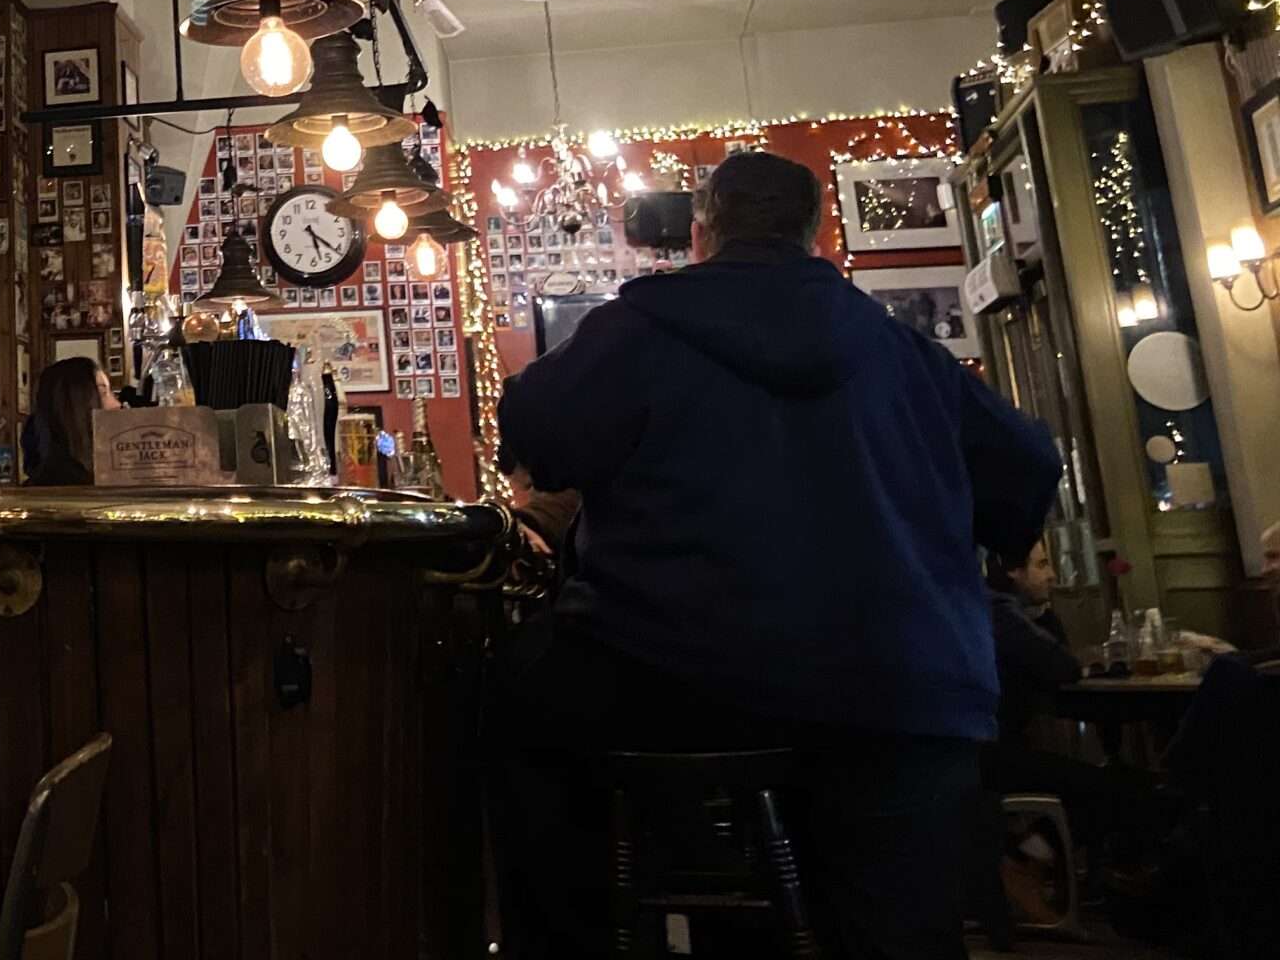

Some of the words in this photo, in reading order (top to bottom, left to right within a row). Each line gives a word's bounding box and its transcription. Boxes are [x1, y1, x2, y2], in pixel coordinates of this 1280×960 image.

[293, 204, 301, 214] 11
[305, 199, 316, 210] 12
[282, 215, 292, 225] 10
[279, 229, 287, 240] 9
[337, 227, 345, 238] 3
[284, 244, 292, 254] 8
[295, 254, 303, 265] 7
[310, 257, 318, 267] 6
[324, 253, 332, 263] 5
[116, 440, 189, 452] GENTLEMAN
[139, 451, 167, 461] JACK
